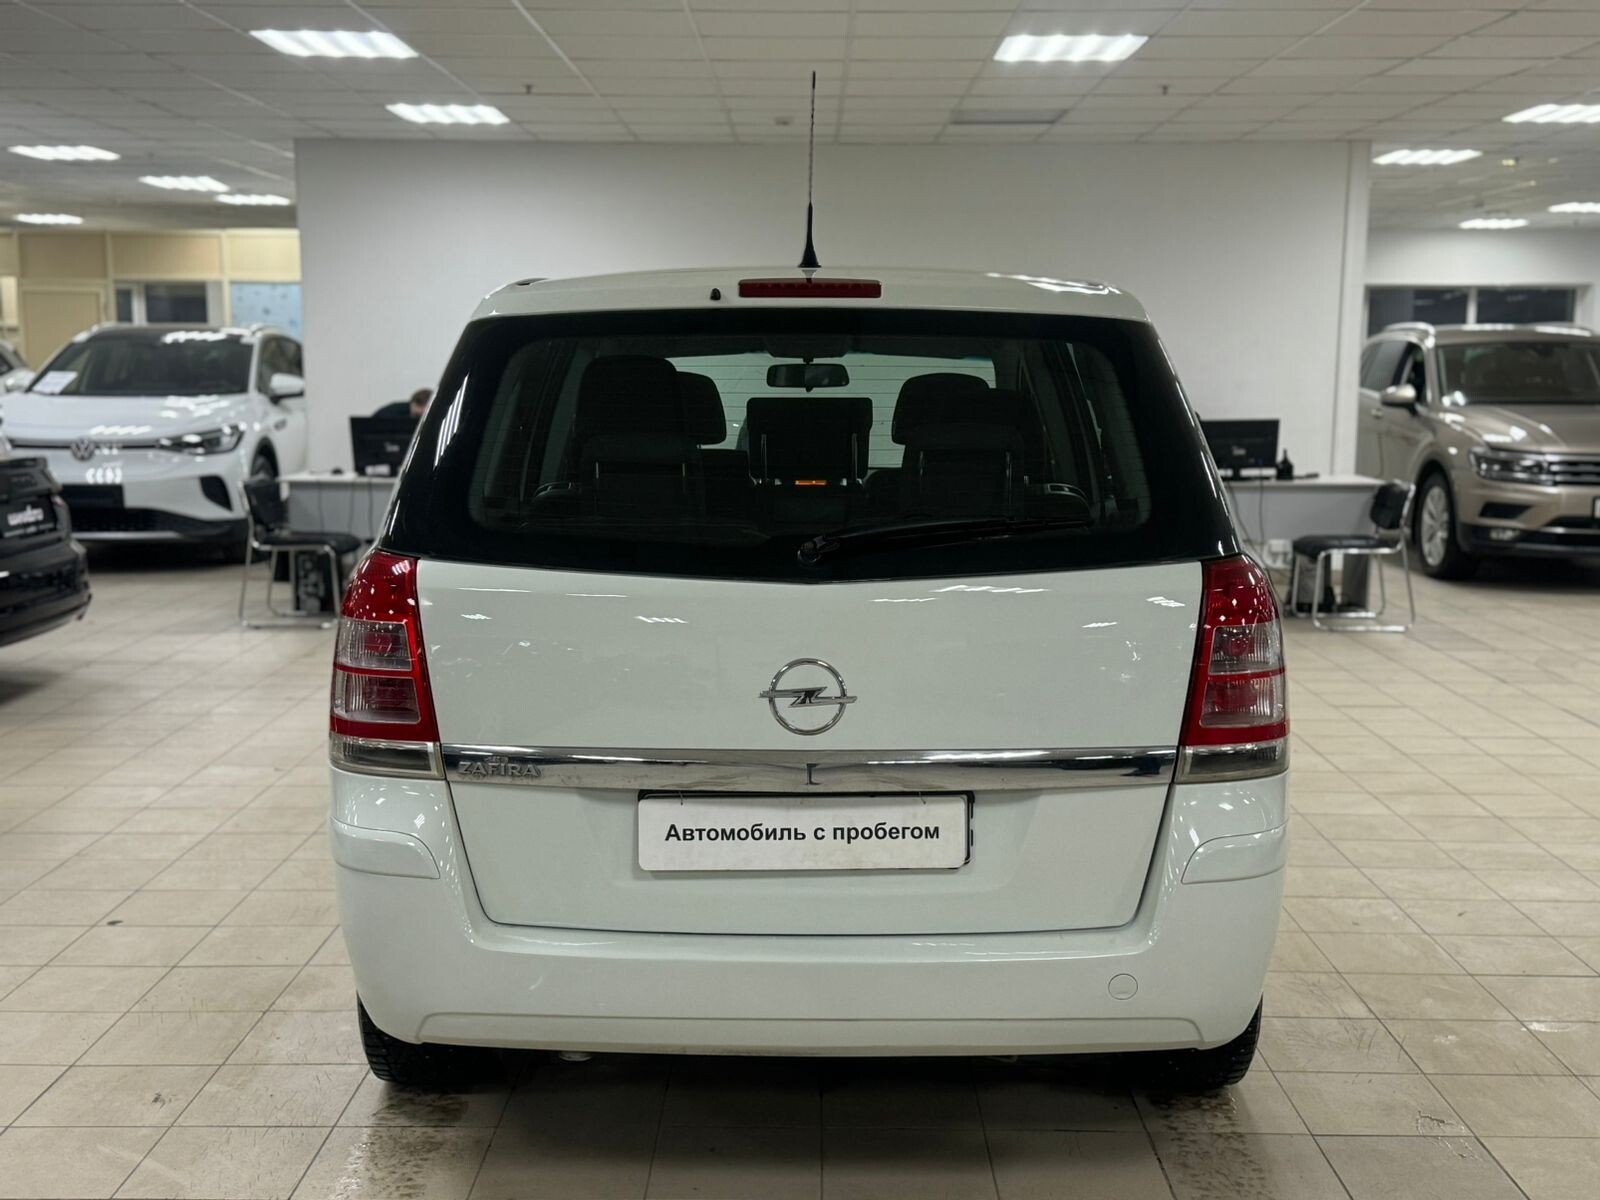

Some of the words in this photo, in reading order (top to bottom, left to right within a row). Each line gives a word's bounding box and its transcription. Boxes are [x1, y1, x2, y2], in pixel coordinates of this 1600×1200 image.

[458, 760, 540, 777] ZAFIRA
[665, 823, 806, 841] Автомобиль
[813, 827, 826, 841] с
[833, 822, 940, 844] пробегом
